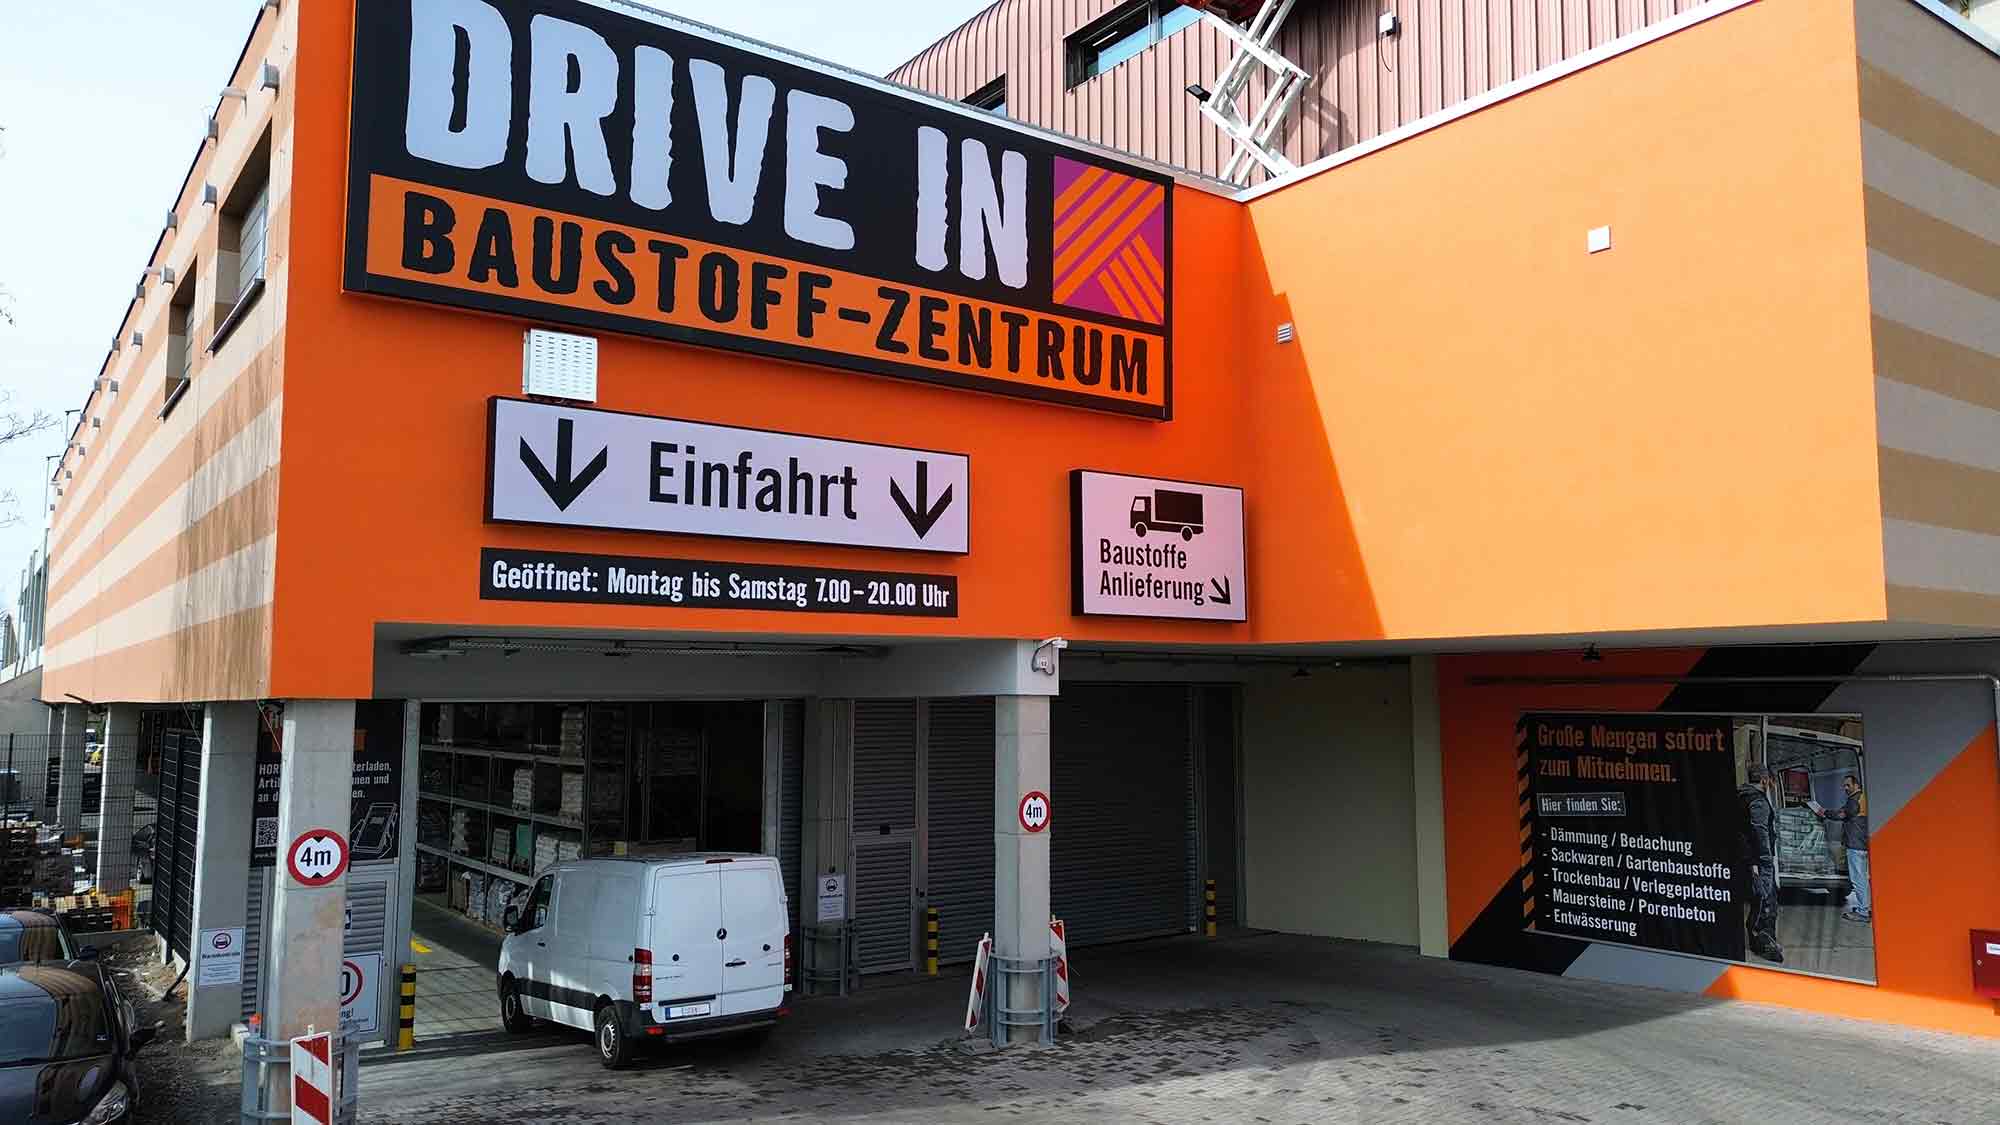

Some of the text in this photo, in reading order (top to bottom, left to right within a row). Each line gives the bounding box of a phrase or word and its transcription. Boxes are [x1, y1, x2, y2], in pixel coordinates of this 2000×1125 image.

[405, 0, 1030, 289] DRIVE IN
[403, 191, 1149, 396] BAUSTOFF-ZENTRUM
[649, 440, 858, 520] Einfahrt
[1100, 538, 1187, 569] Baustoffe
[491, 559, 600, 594] Geöffnet:
[607, 566, 684, 602] Montag
[692, 572, 721, 599] bis
[728, 573, 808, 607] Samstag
[922, 583, 950, 609] Uhr
[1100, 570, 1204, 606] Anlieferung
[1537, 724, 1725, 755] Große Mengen sofort
[373, 773, 390, 785] und
[1539, 755, 1679, 783] zum Mitnehmen.
[1025, 803, 1043, 819] 4m
[1541, 797, 1622, 812] Hier finden Sie:
[300, 847, 332, 867] 4m
[1550, 826, 1609, 849] Dämmung
[1619, 833, 1694, 857] Bedachung
[1551, 847, 1615, 868] Sackwaren
[1625, 854, 1732, 881] Gartenbaustoffe
[1551, 867, 1621, 890] Trockenbau
[1631, 876, 1731, 902] Verlegeplatten
[1552, 888, 1627, 912] Mauersteine
[1638, 899, 1717, 924] Porenbeton
[1553, 908, 1638, 937] Entwässerung
